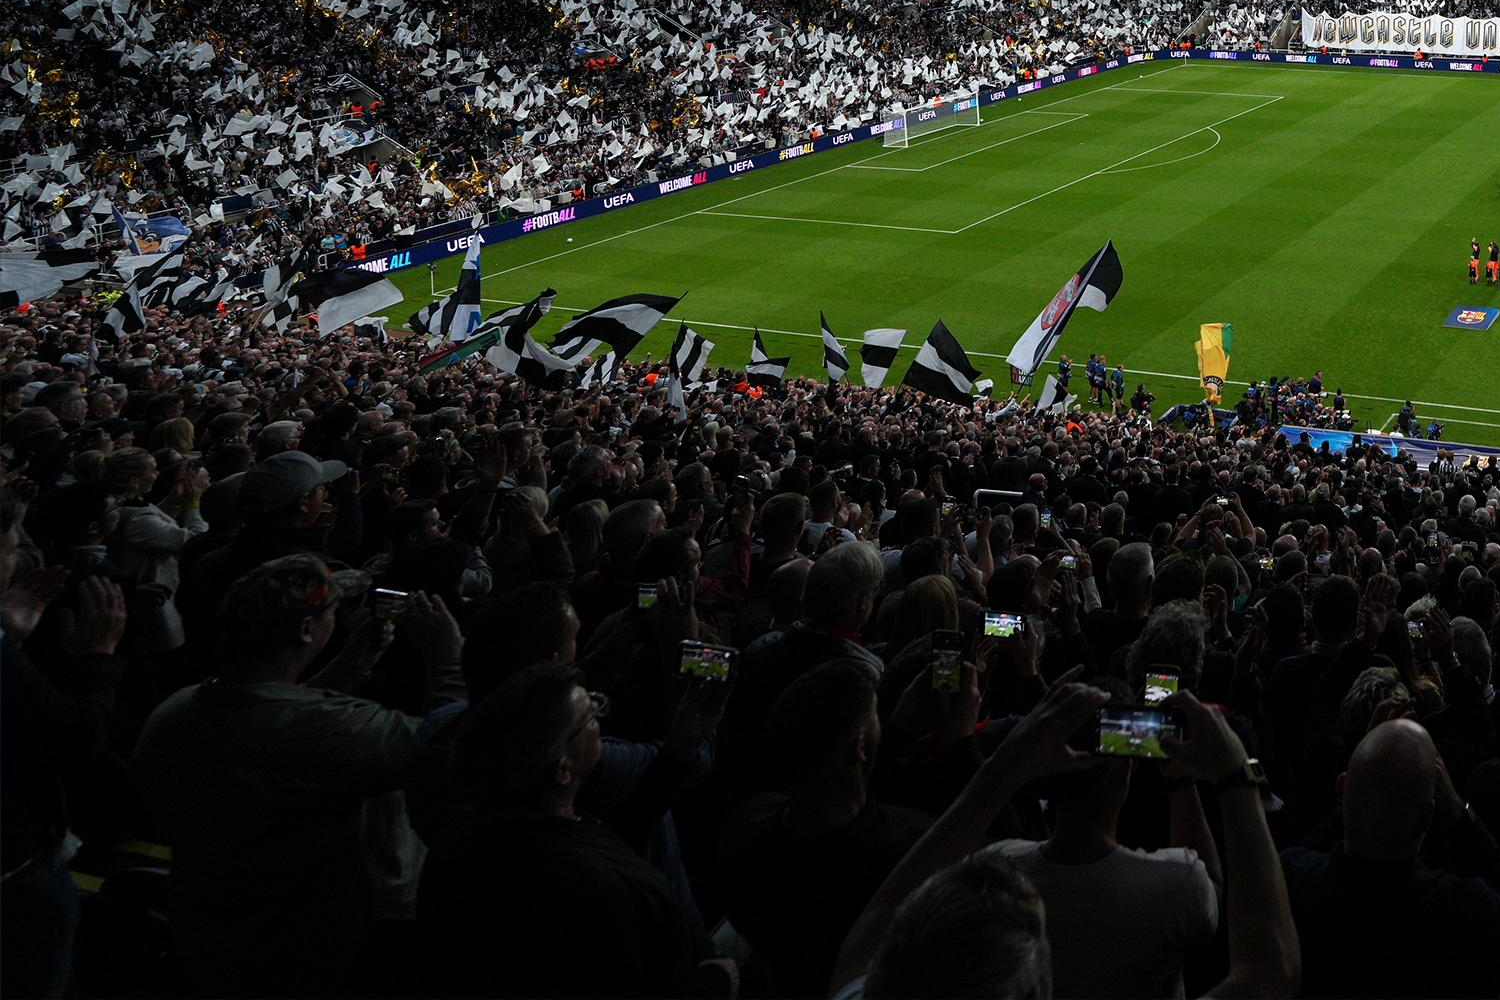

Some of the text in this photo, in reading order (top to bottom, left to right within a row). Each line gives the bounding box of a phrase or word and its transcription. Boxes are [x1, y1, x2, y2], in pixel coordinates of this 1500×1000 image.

[1170, 50, 1190, 58] UEFA
[1209, 51, 1237, 59] #FOOTBALL
[1286, 54, 1317, 64] WELCOME ALL
[1106, 60, 1119, 69] UEFA
[1332, 57, 1351, 65] UEFA
[1369, 58, 1399, 67] #FOOTBALL
[1414, 61, 1434, 69] UEFA
[1450, 62, 1483, 72] WELCOME ALL
[1052, 74, 1066, 84] UEFA
[990, 91, 1006, 101] UEFA
[918, 110, 936, 122] UEFA
[870, 117, 904, 136] WELCOME ALL
[833, 132, 853, 145] UEFA
[779, 142, 815, 161] #FOOTBALL
[729, 160, 754, 173] UEFA
[659, 171, 707, 194] WELCOME ALL
[604, 192, 634, 208] UEFA
[522, 207, 576, 232] #FOOTBALL
[389, 252, 411, 270] ALL
